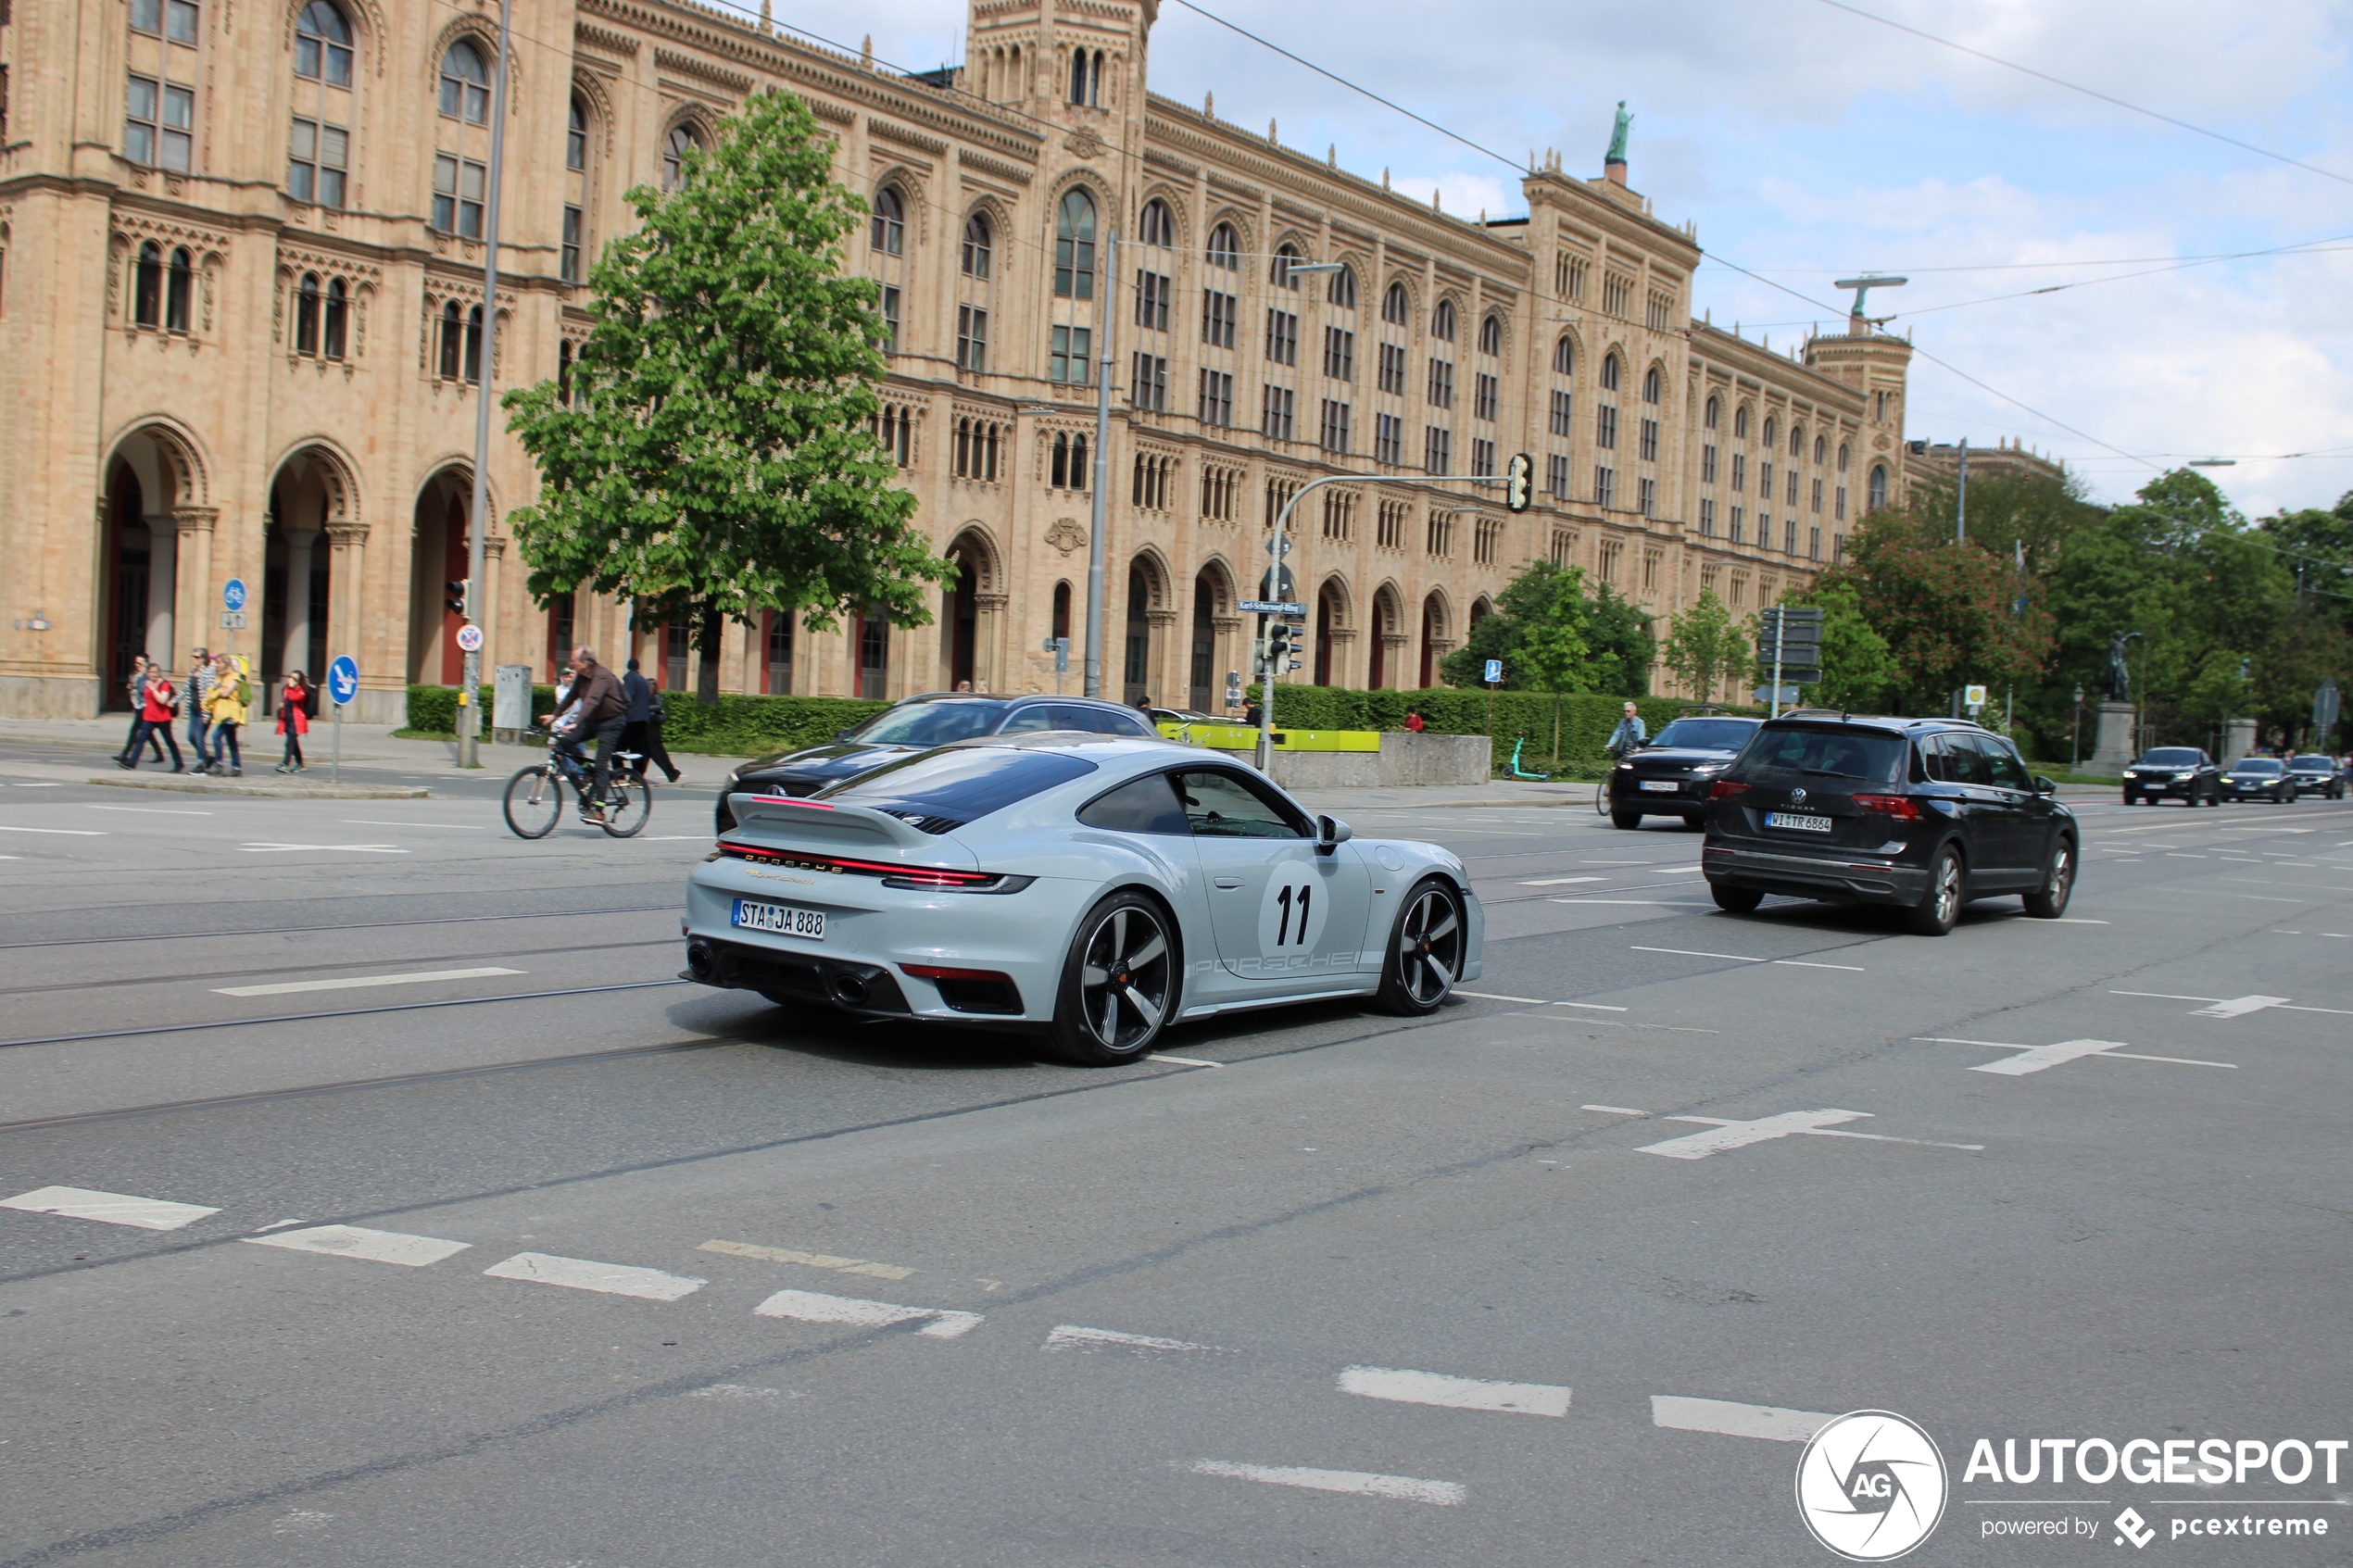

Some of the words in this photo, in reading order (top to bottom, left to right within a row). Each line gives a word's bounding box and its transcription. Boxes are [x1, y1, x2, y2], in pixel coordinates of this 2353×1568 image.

[1773, 814, 1784, 826] WI
[1793, 816, 1805, 828] TR
[1806, 817, 1831, 831] 6864
[745, 854, 843, 874] PORSCHE
[741, 903, 765, 926] STA
[775, 909, 792, 931] JA
[796, 911, 824, 935] 888
[1277, 884, 1311, 947] 11
[1195, 951, 1354, 975] PORSCHE
